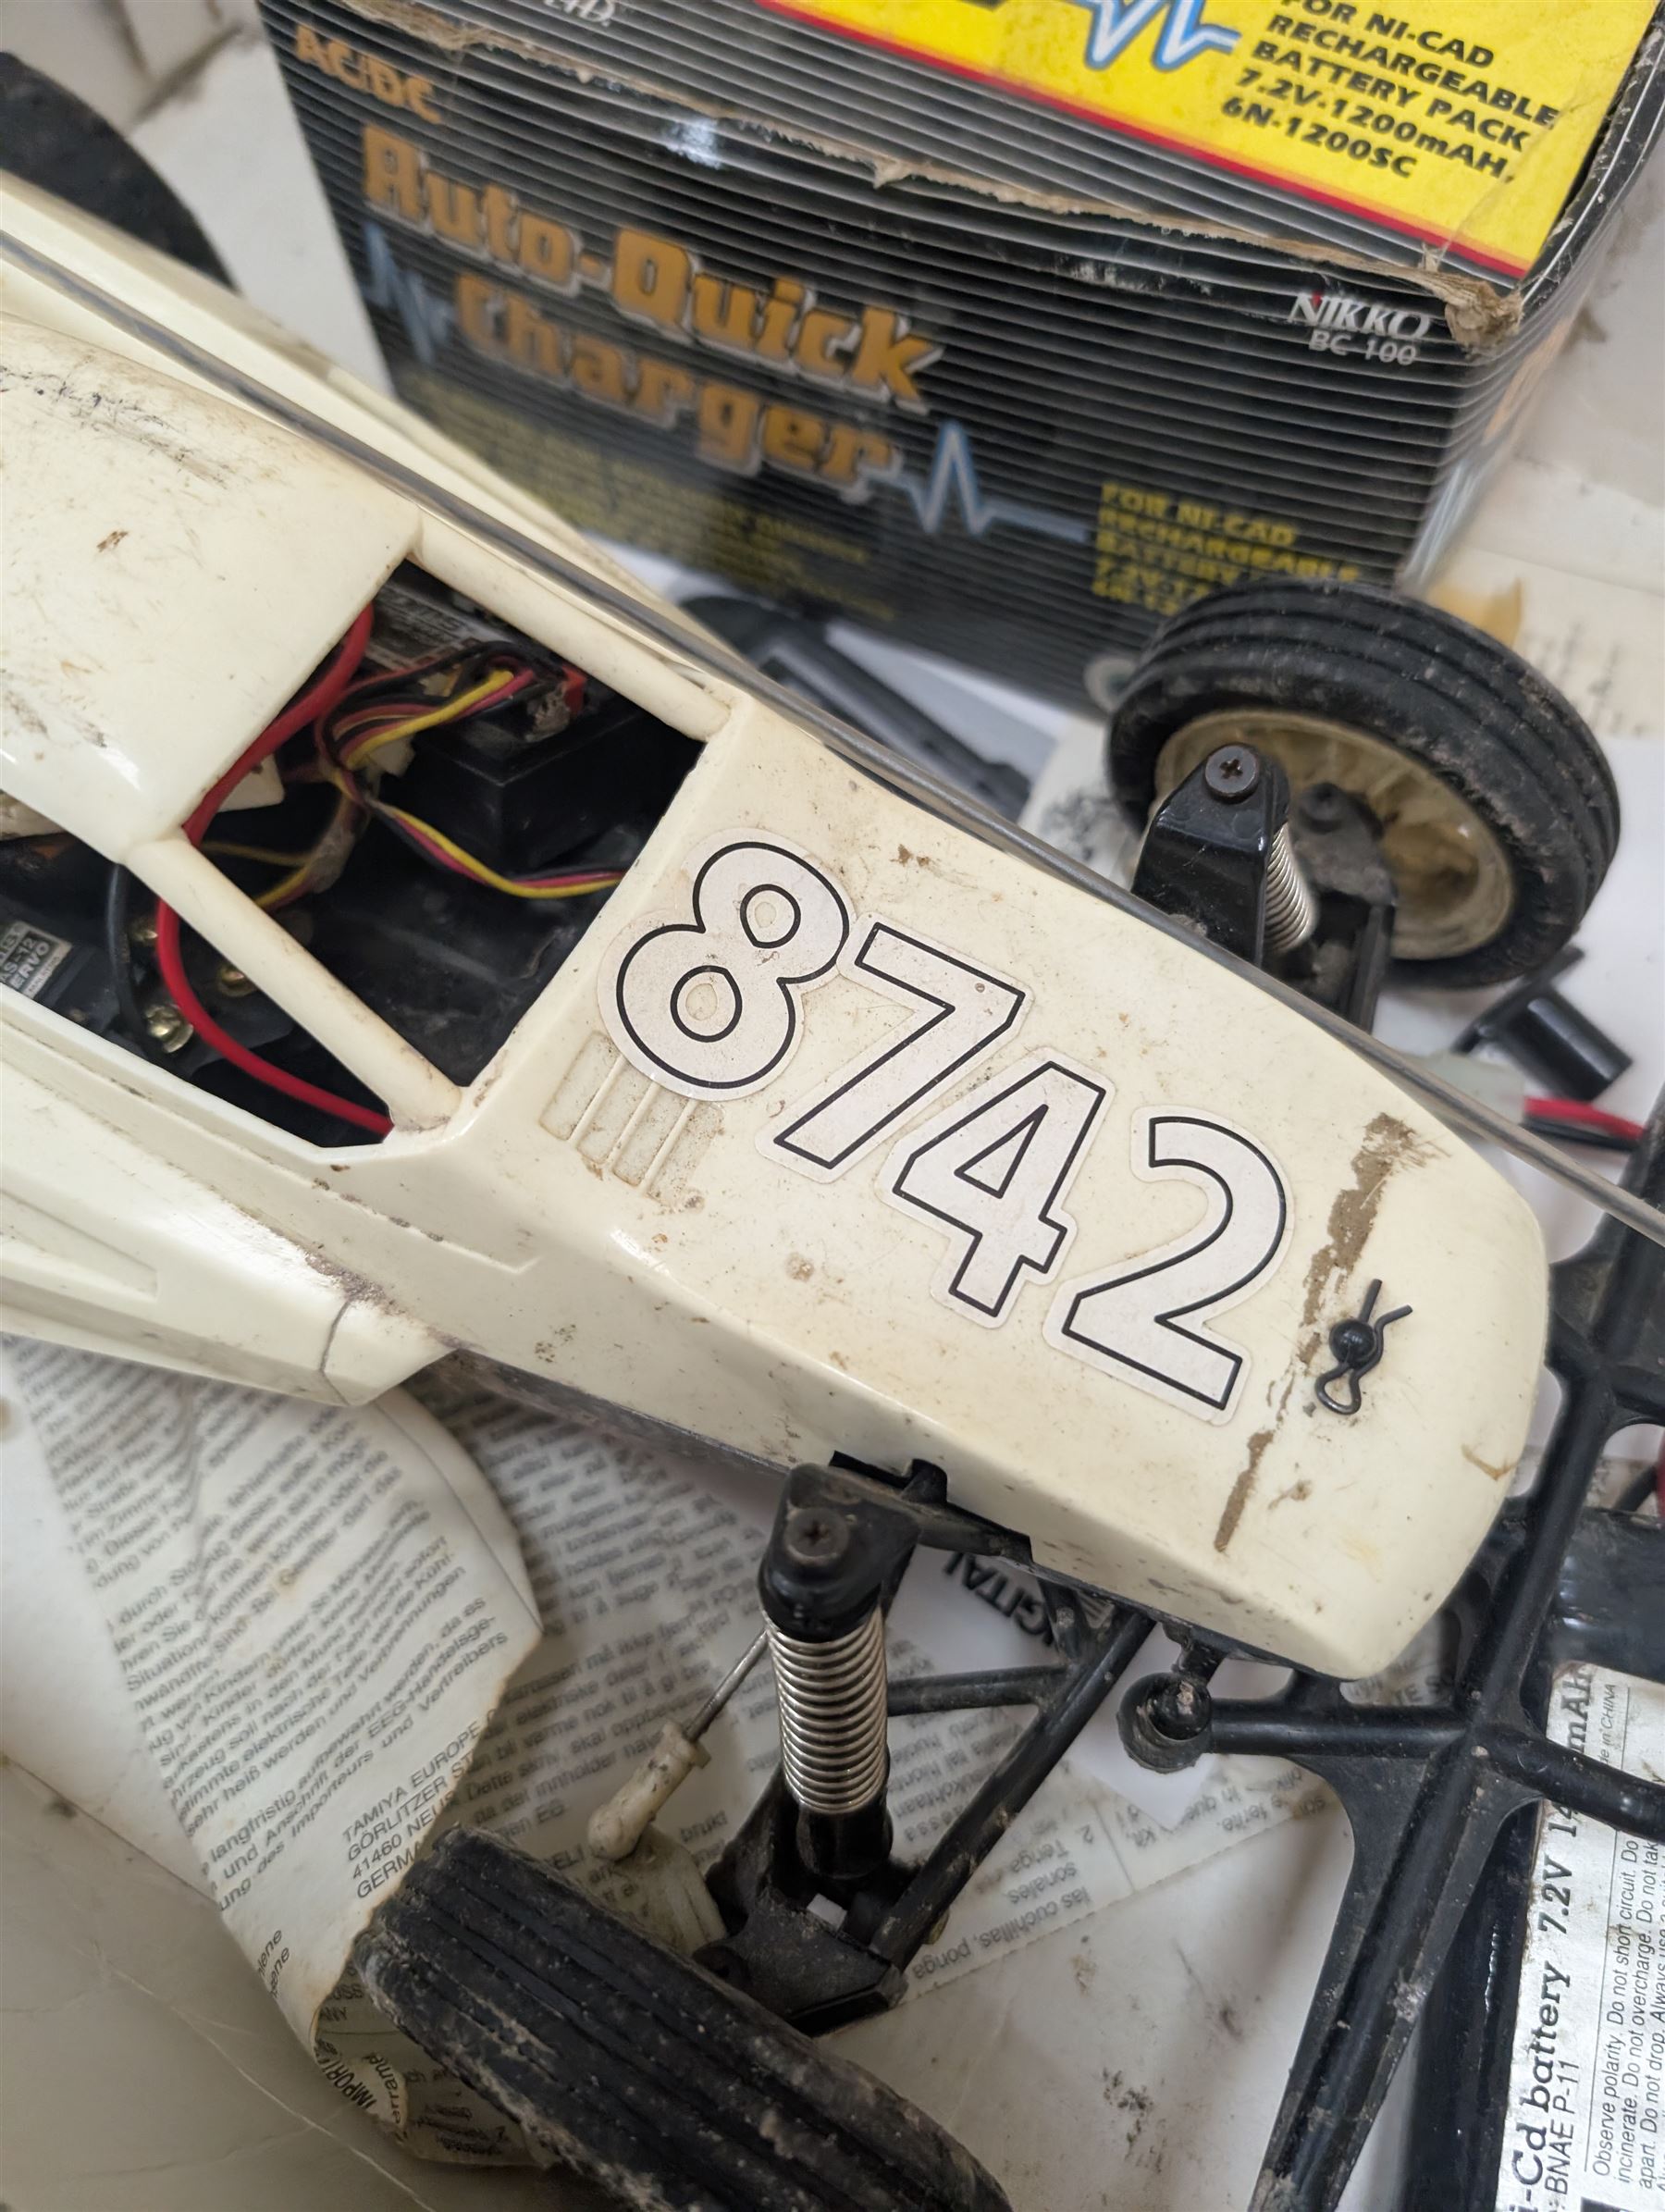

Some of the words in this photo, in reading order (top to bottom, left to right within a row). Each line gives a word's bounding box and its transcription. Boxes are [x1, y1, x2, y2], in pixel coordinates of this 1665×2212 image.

[1365, 13, 1495, 68] NI-CAD
[294, 22, 442, 124] AC/DC
[1252, 40, 1421, 108] BATTERY
[1426, 97, 1531, 152] PACK
[1266, 14, 1560, 130] RECHARGEABLE
[1222, 96, 1417, 179] 6N-1200SC
[363, 122, 943, 414] Auto-Quick
[1287, 292, 1431, 340] NIKKO
[1309, 329, 1351, 355] BC
[1364, 339, 1417, 365] 100
[455, 276, 905, 504] Charger
[616, 841, 1287, 1411] 8742
[1601, 1683, 1617, 1730] CHINA
[341, 1782, 406, 1844] TAMIYA
[409, 1718, 481, 1789] EUROPE
[210, 1785, 297, 1863] langfristig
[344, 1774, 447, 1862] GÖRLITZER
[222, 1841, 260, 1882] und
[349, 1831, 401, 1881] 41460
[1621, 1838, 1639, 1861] Do
[1641, 1840, 1659, 1864] tak
[1062, 1885, 1090, 1913] las
[1536, 1854, 1573, 1934] 7.2V
[1638, 1869, 1657, 1894] not
[973, 1898, 1059, 1954] cuchillas,
[1635, 1899, 1654, 1922] Do
[910, 1937, 969, 1979] ponga
[1610, 1970, 1628, 1996] not
[1629, 1927, 1655, 2025] overcharge.
[1520, 1959, 1572, 2113] battery
[1606, 2000, 1624, 2024] Do
[1625, 2029, 1644, 2057] not
[1552, 2060, 1581, 2113] P-11
[1622, 2061, 1640, 2085] Do
[1641, 2074, 1661, 2102] not
[1592, 2101, 1617, 2175] Observe
[1639, 2107, 1659, 2132] Do
[1541, 2119, 1575, 2194] BNAE
